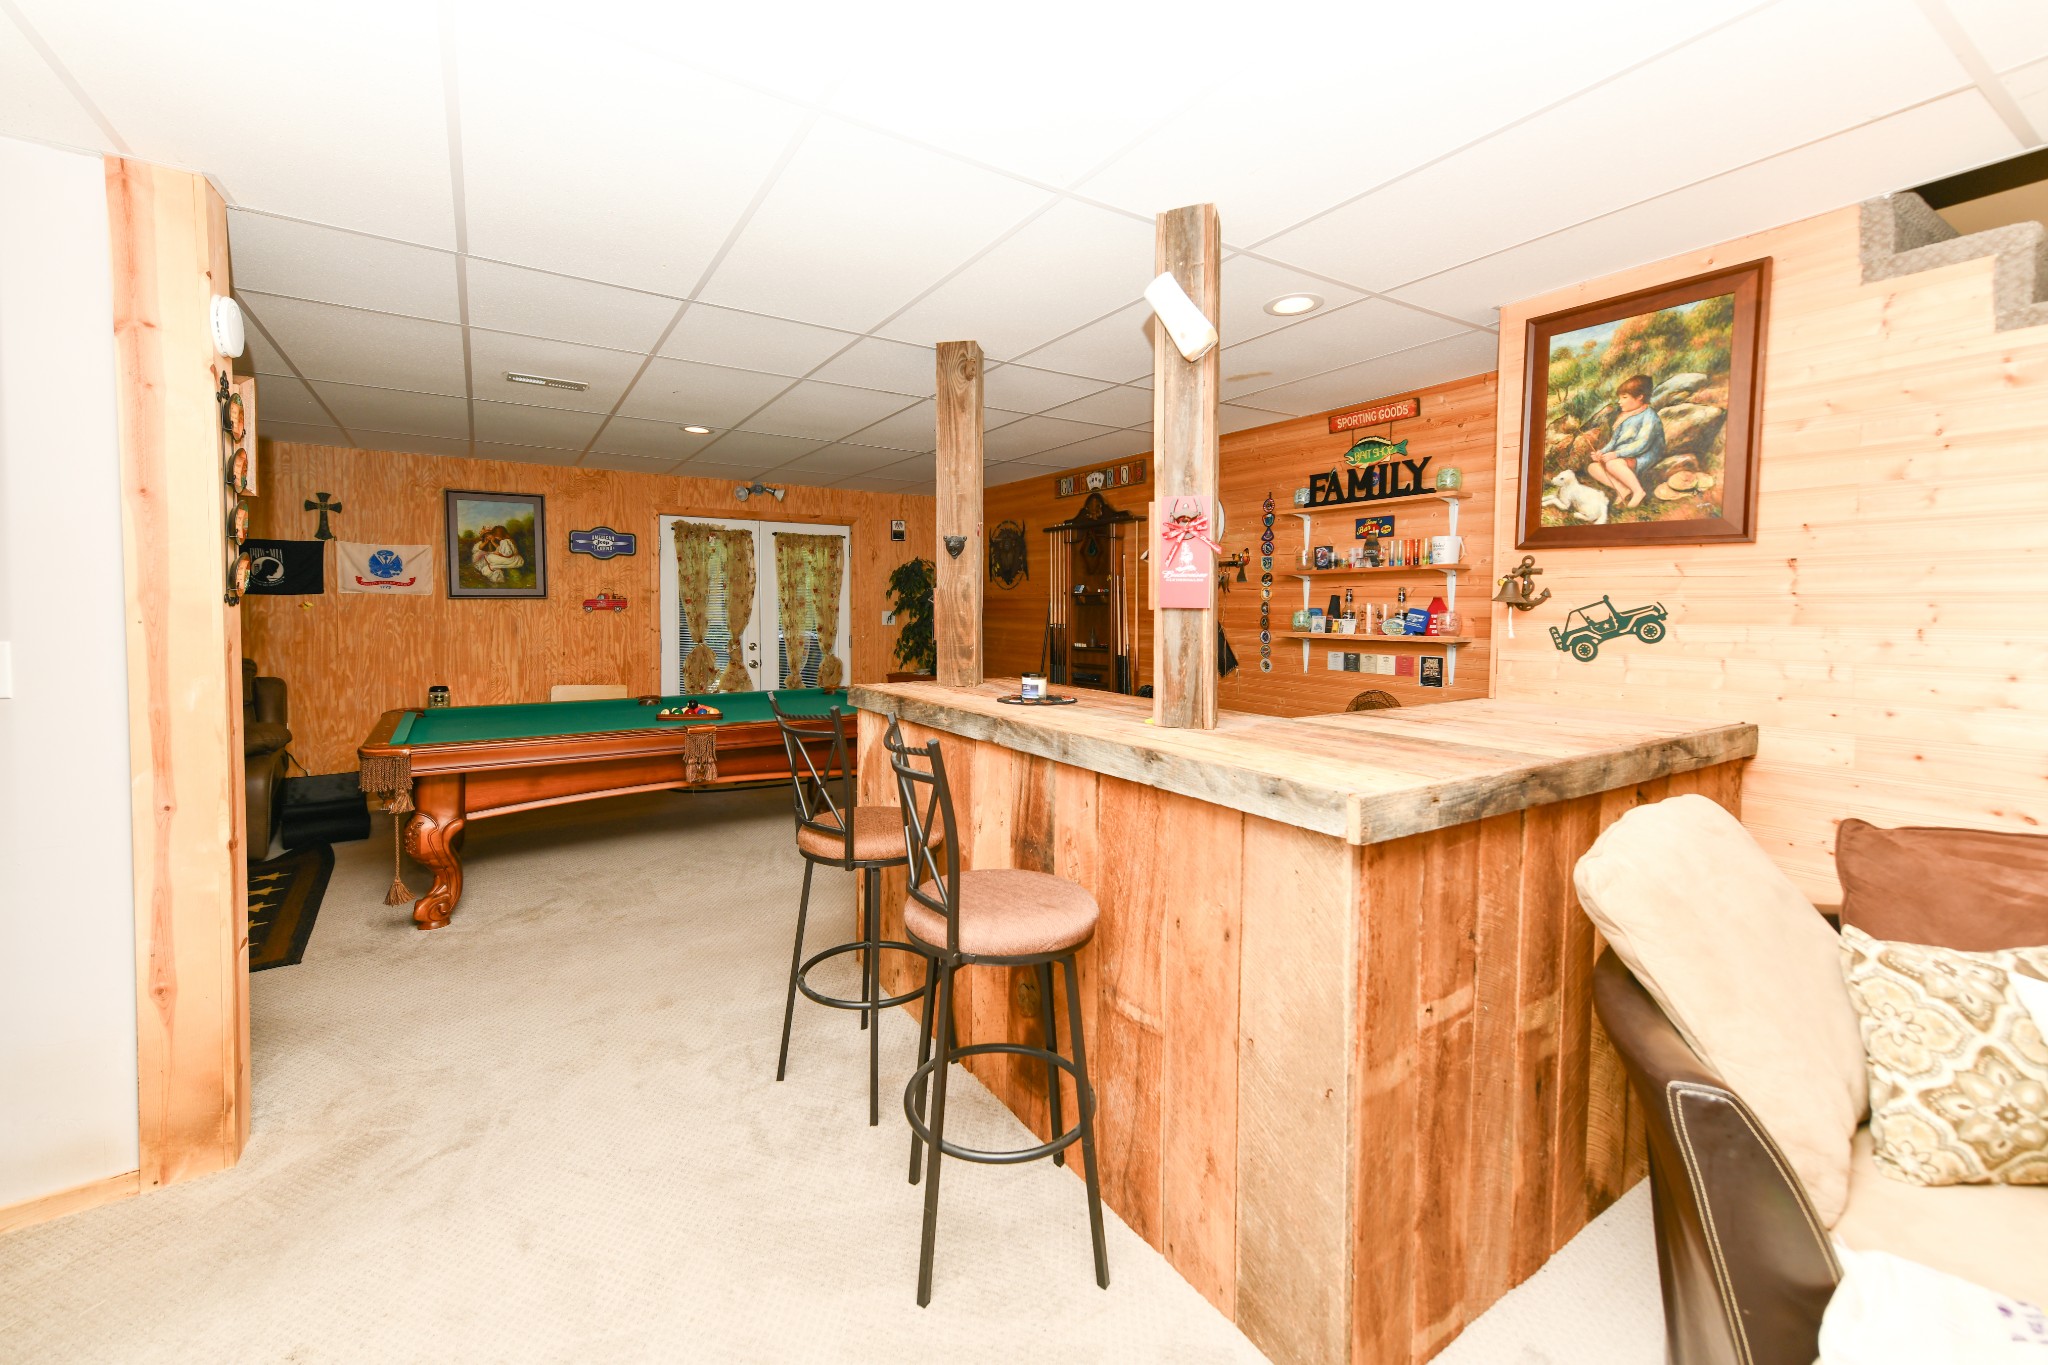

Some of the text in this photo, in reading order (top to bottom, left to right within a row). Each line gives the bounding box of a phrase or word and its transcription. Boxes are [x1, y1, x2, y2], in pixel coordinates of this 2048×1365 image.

[1337, 404, 1409, 429] SPORTING GOODS
[1354, 445, 1394, 462] BAIT SHOP
[1304, 456, 1436, 508] FAMILY
[591, 534, 615, 542] AMERICAN
[1356, 525, 1371, 535] Bar
[249, 547, 284, 564] POW MIA
[1162, 570, 1208, 579] Budweiser
